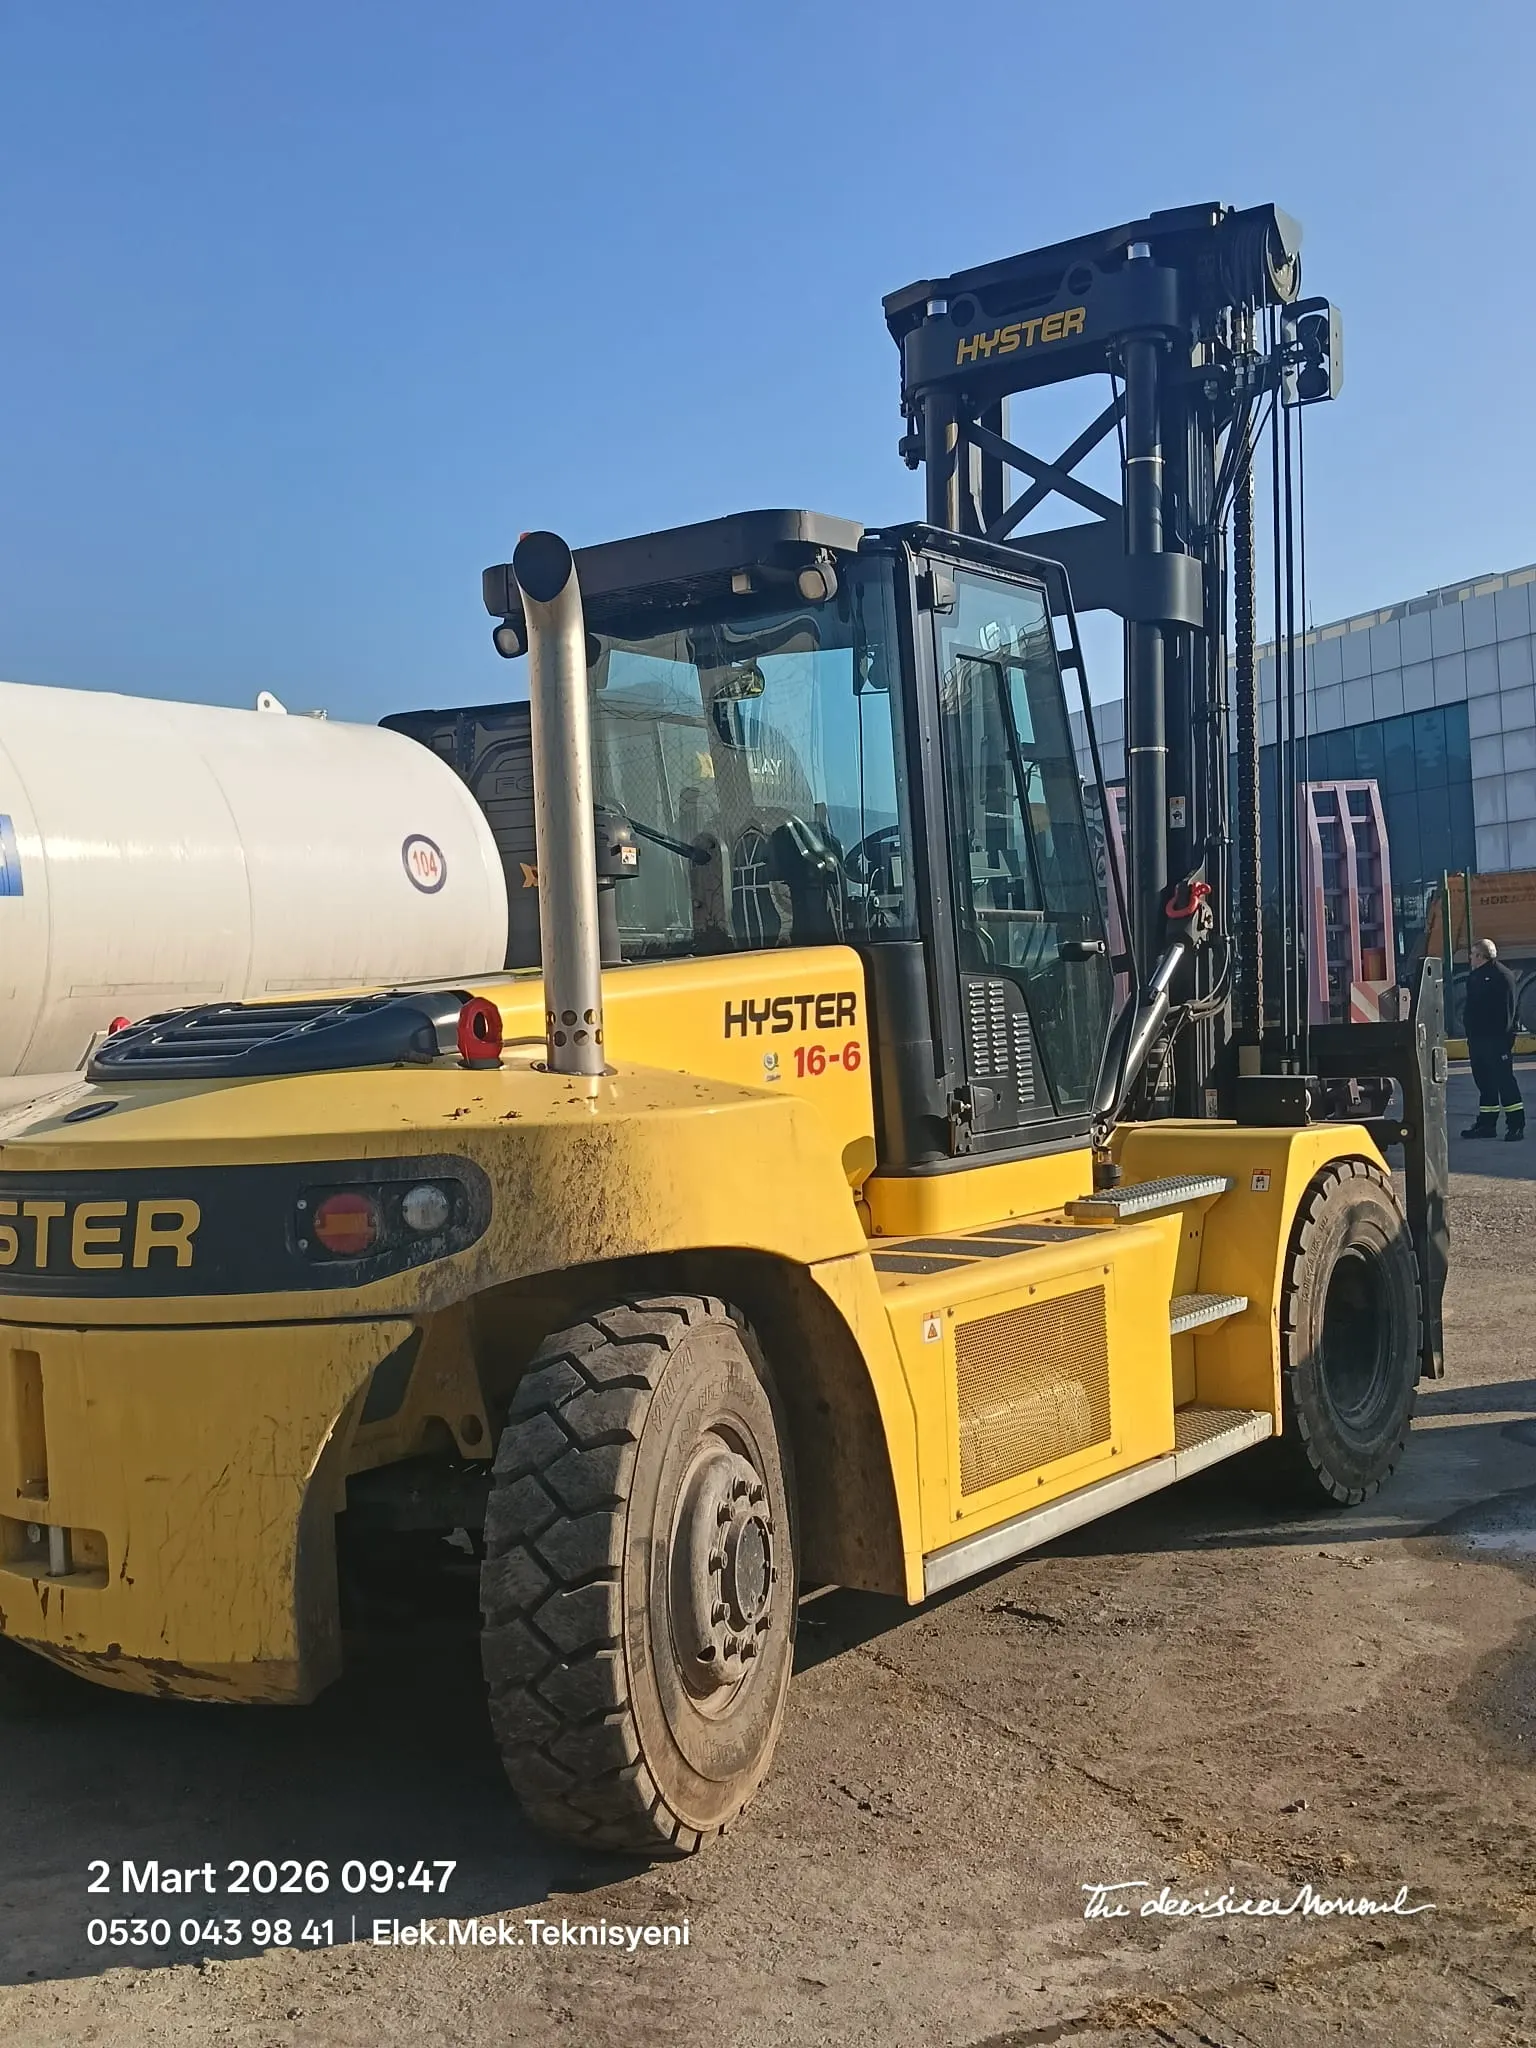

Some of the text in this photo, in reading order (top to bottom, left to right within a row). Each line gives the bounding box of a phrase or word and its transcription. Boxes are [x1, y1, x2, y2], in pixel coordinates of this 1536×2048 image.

[957, 306, 1086, 365] HYSTER
[412, 850, 438, 877] 104
[724, 991, 857, 1039] HYSTER
[794, 1041, 861, 1078] 16-6
